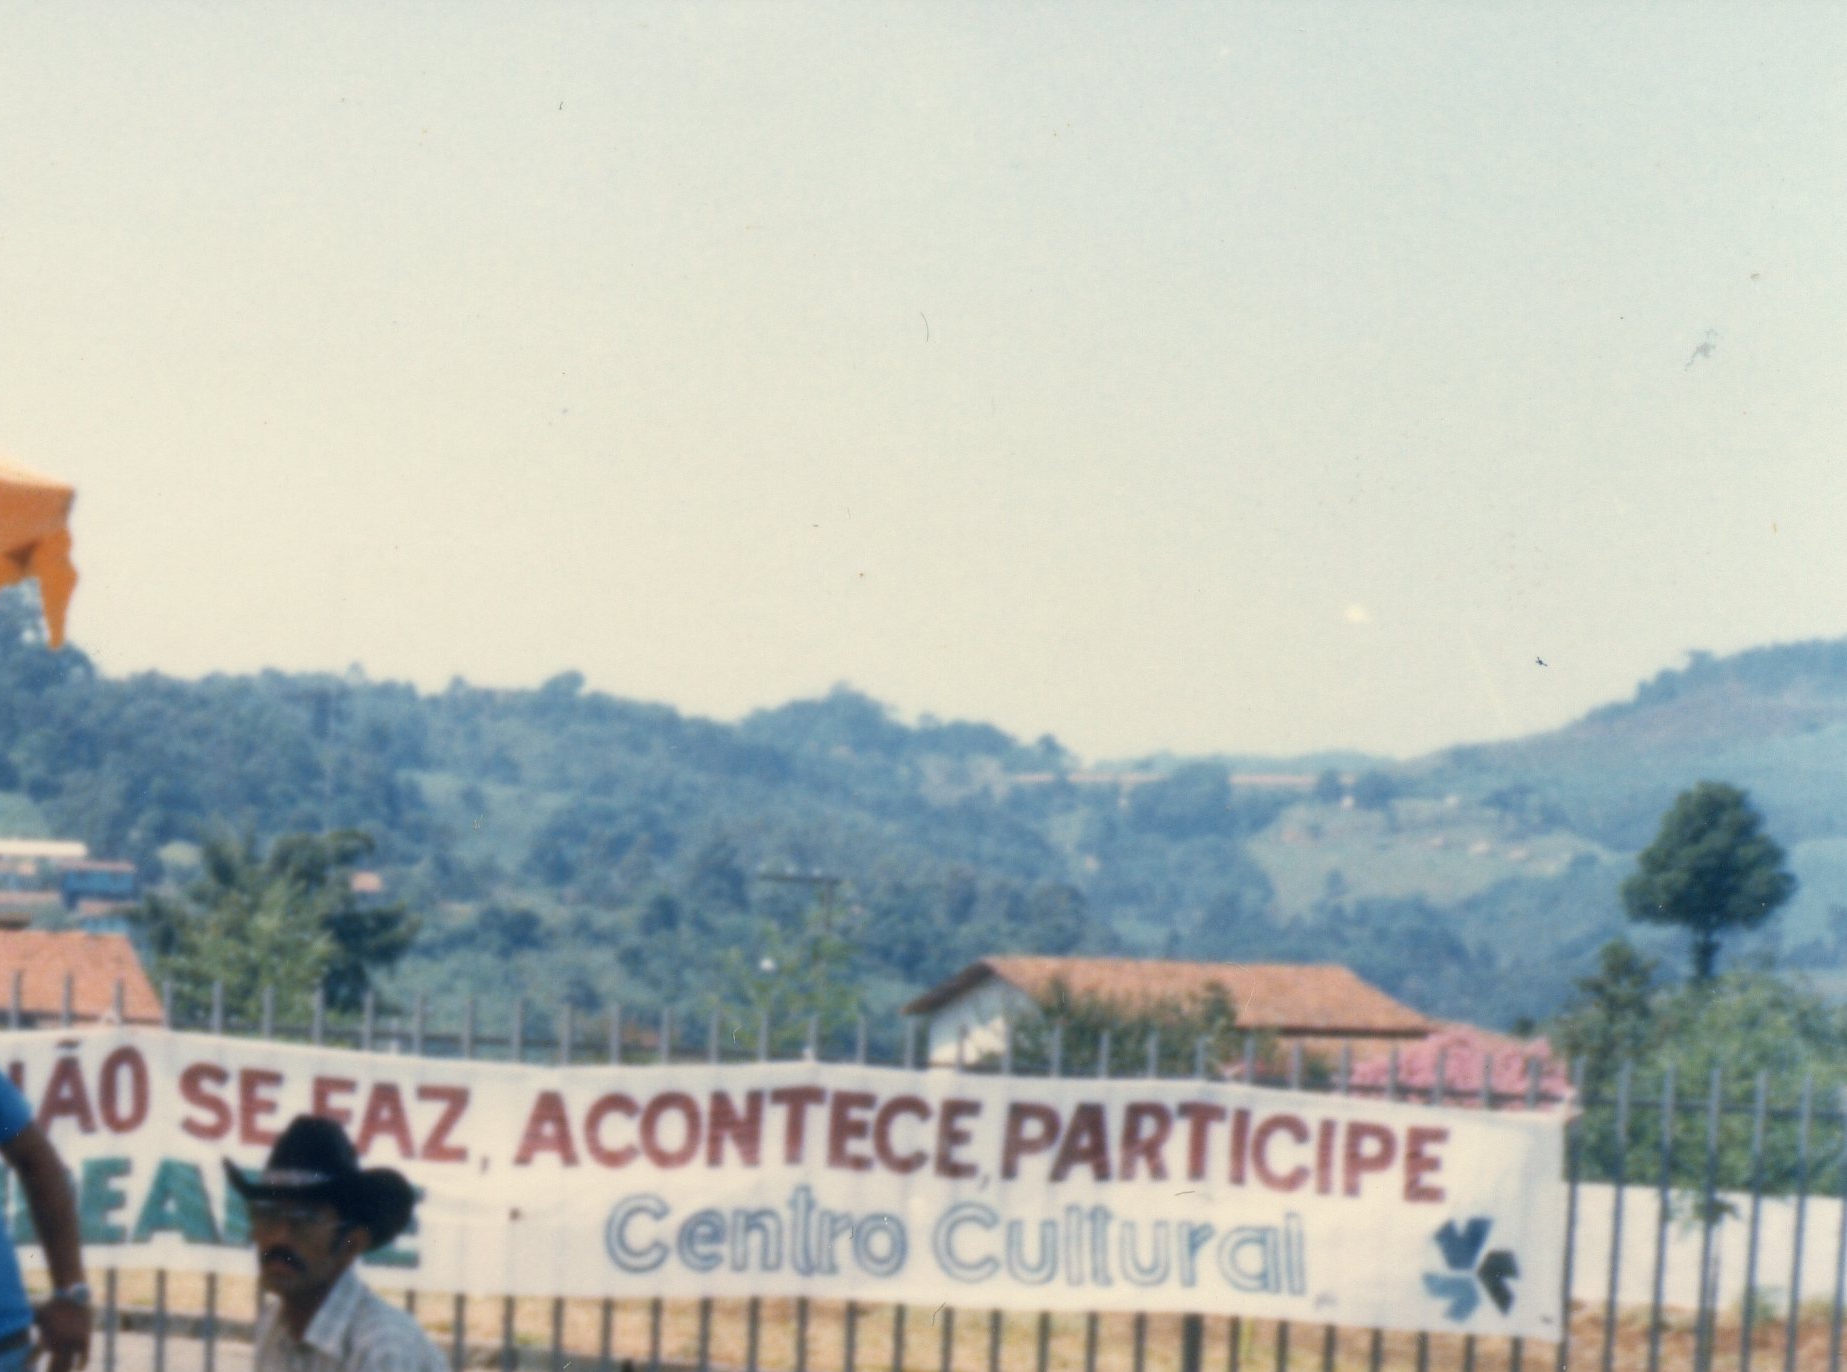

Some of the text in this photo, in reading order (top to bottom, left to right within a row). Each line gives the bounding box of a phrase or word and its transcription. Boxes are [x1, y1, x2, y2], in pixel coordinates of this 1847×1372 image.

[9, 1040, 150, 1134] ÃO
[178, 1061, 284, 1147] SE
[1001, 1101, 1449, 1204] PARTICIPE
[605, 1187, 1307, 1297] Centro Cultural
